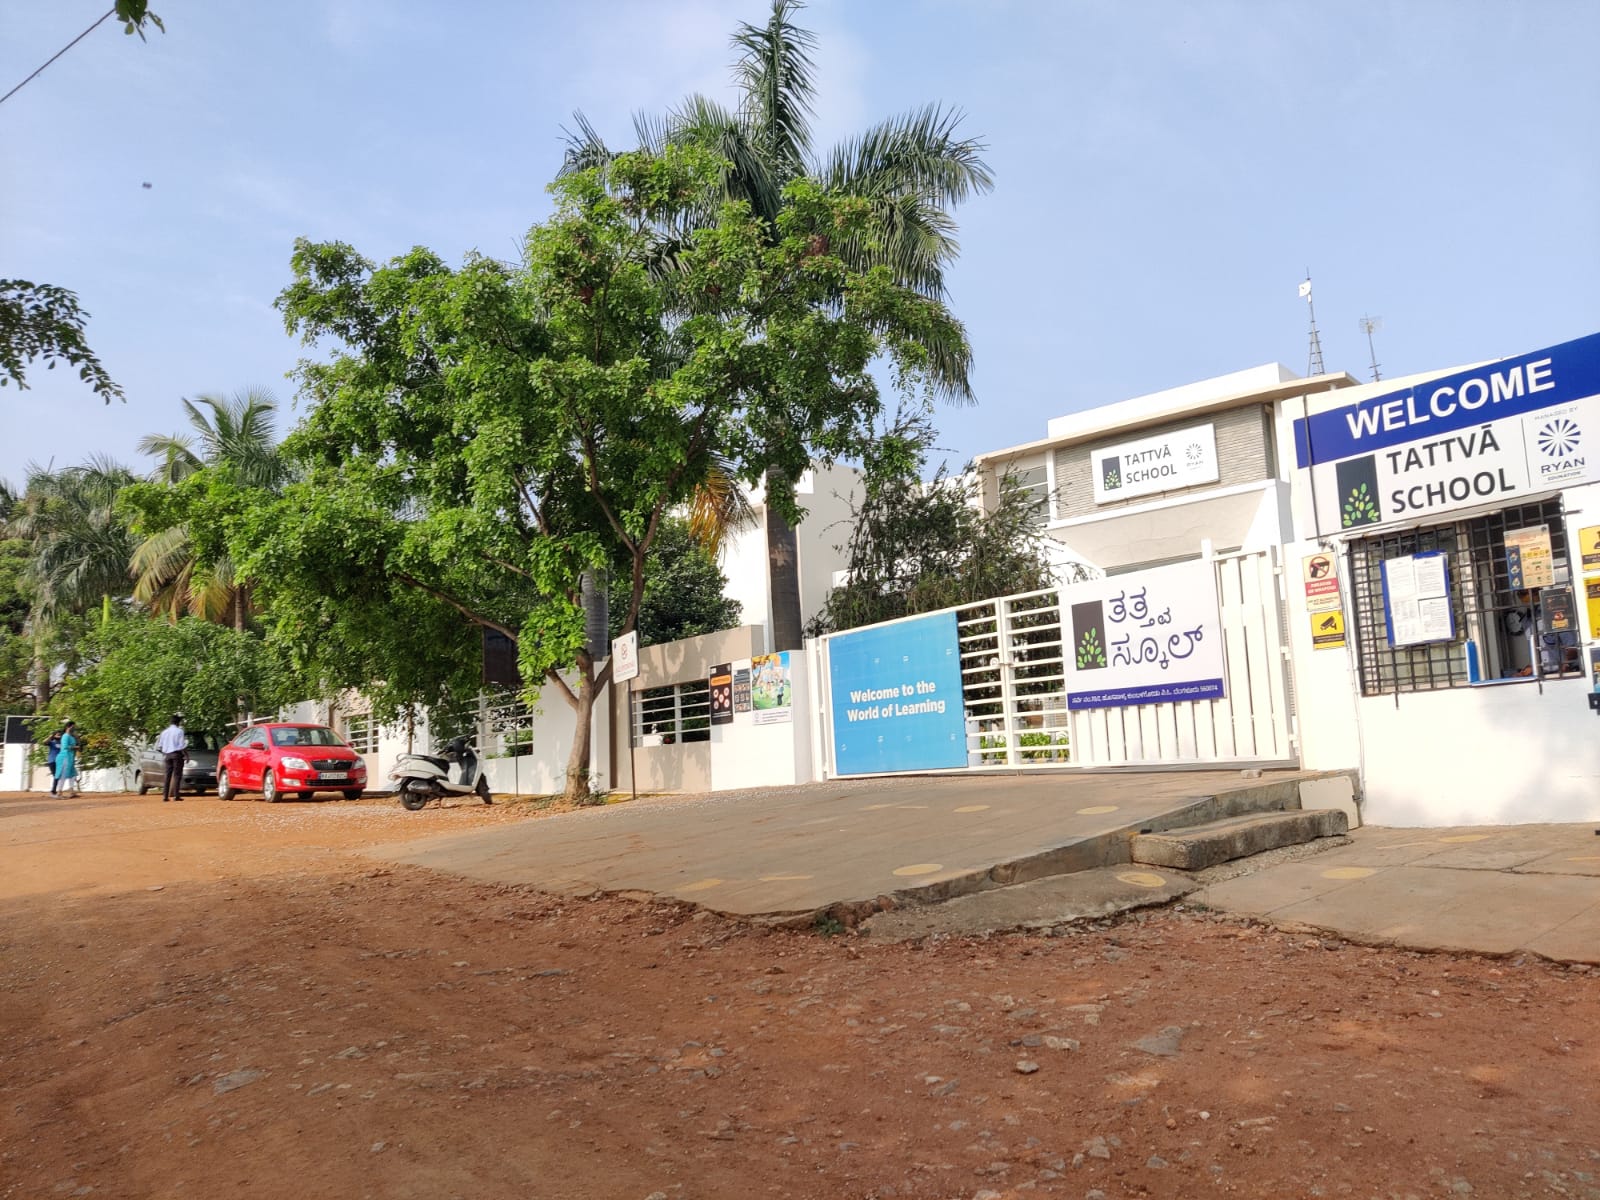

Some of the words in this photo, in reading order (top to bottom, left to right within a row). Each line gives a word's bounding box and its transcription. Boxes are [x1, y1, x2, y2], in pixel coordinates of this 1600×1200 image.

[1346, 358, 1555, 440] WELCOME
[1125, 445, 1171, 466] TATTVĀ
[1386, 425, 1500, 475] TATTVĀ
[1126, 464, 1177, 484] SCHOOL
[1541, 457, 1585, 474] RYAN
[1391, 468, 1516, 514] SCHOOL
[1111, 624, 1203, 670] ಸ್ಕೂಲ್
[849, 687, 899, 704] Welcome
[901, 684, 914, 697] to
[916, 680, 936, 694] the
[847, 705, 879, 722] World
[881, 703, 894, 717] of
[895, 699, 945, 717] Learning
